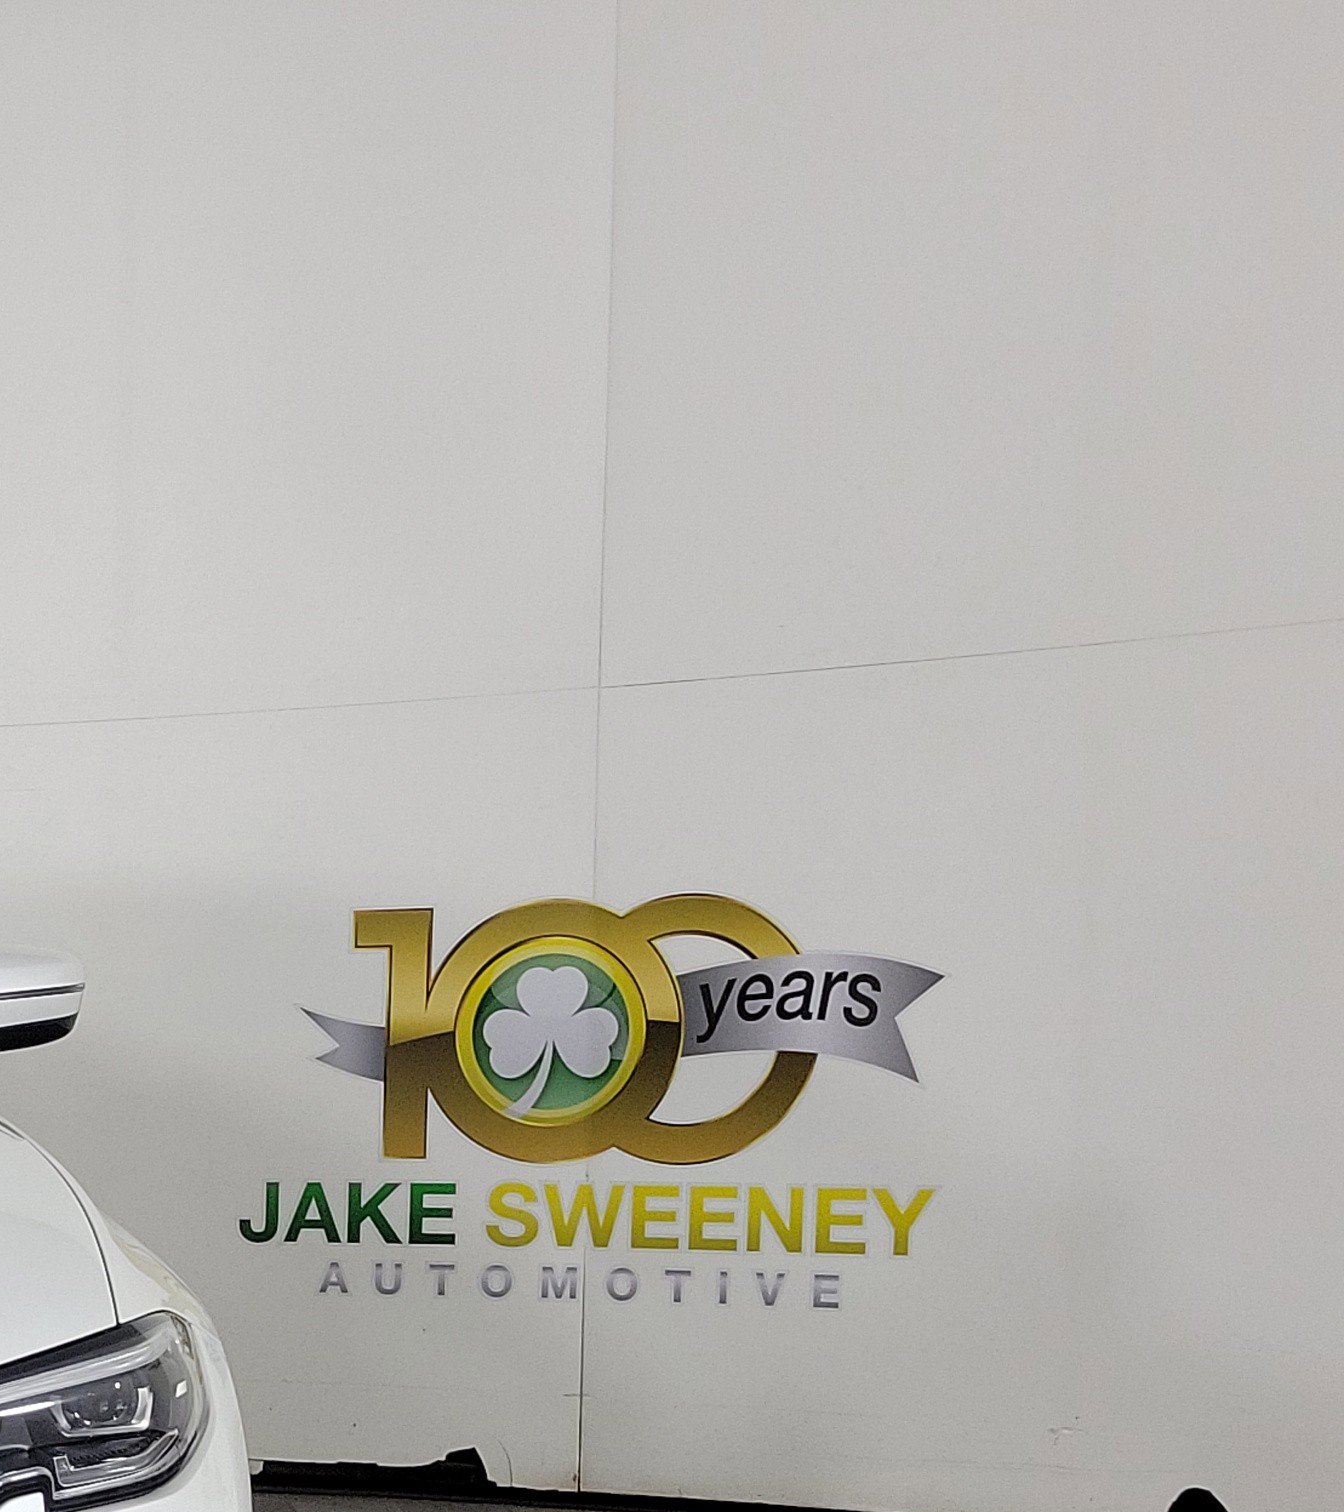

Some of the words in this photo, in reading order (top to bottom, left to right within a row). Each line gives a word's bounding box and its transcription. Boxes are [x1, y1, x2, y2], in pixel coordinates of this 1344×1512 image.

[353, 893, 818, 1165] 100
[696, 969, 882, 1043] years
[239, 1182, 457, 1244] JAKE
[485, 1182, 935, 1256] SWEENEY
[318, 1262, 841, 1309] AUTOMOTIVE
